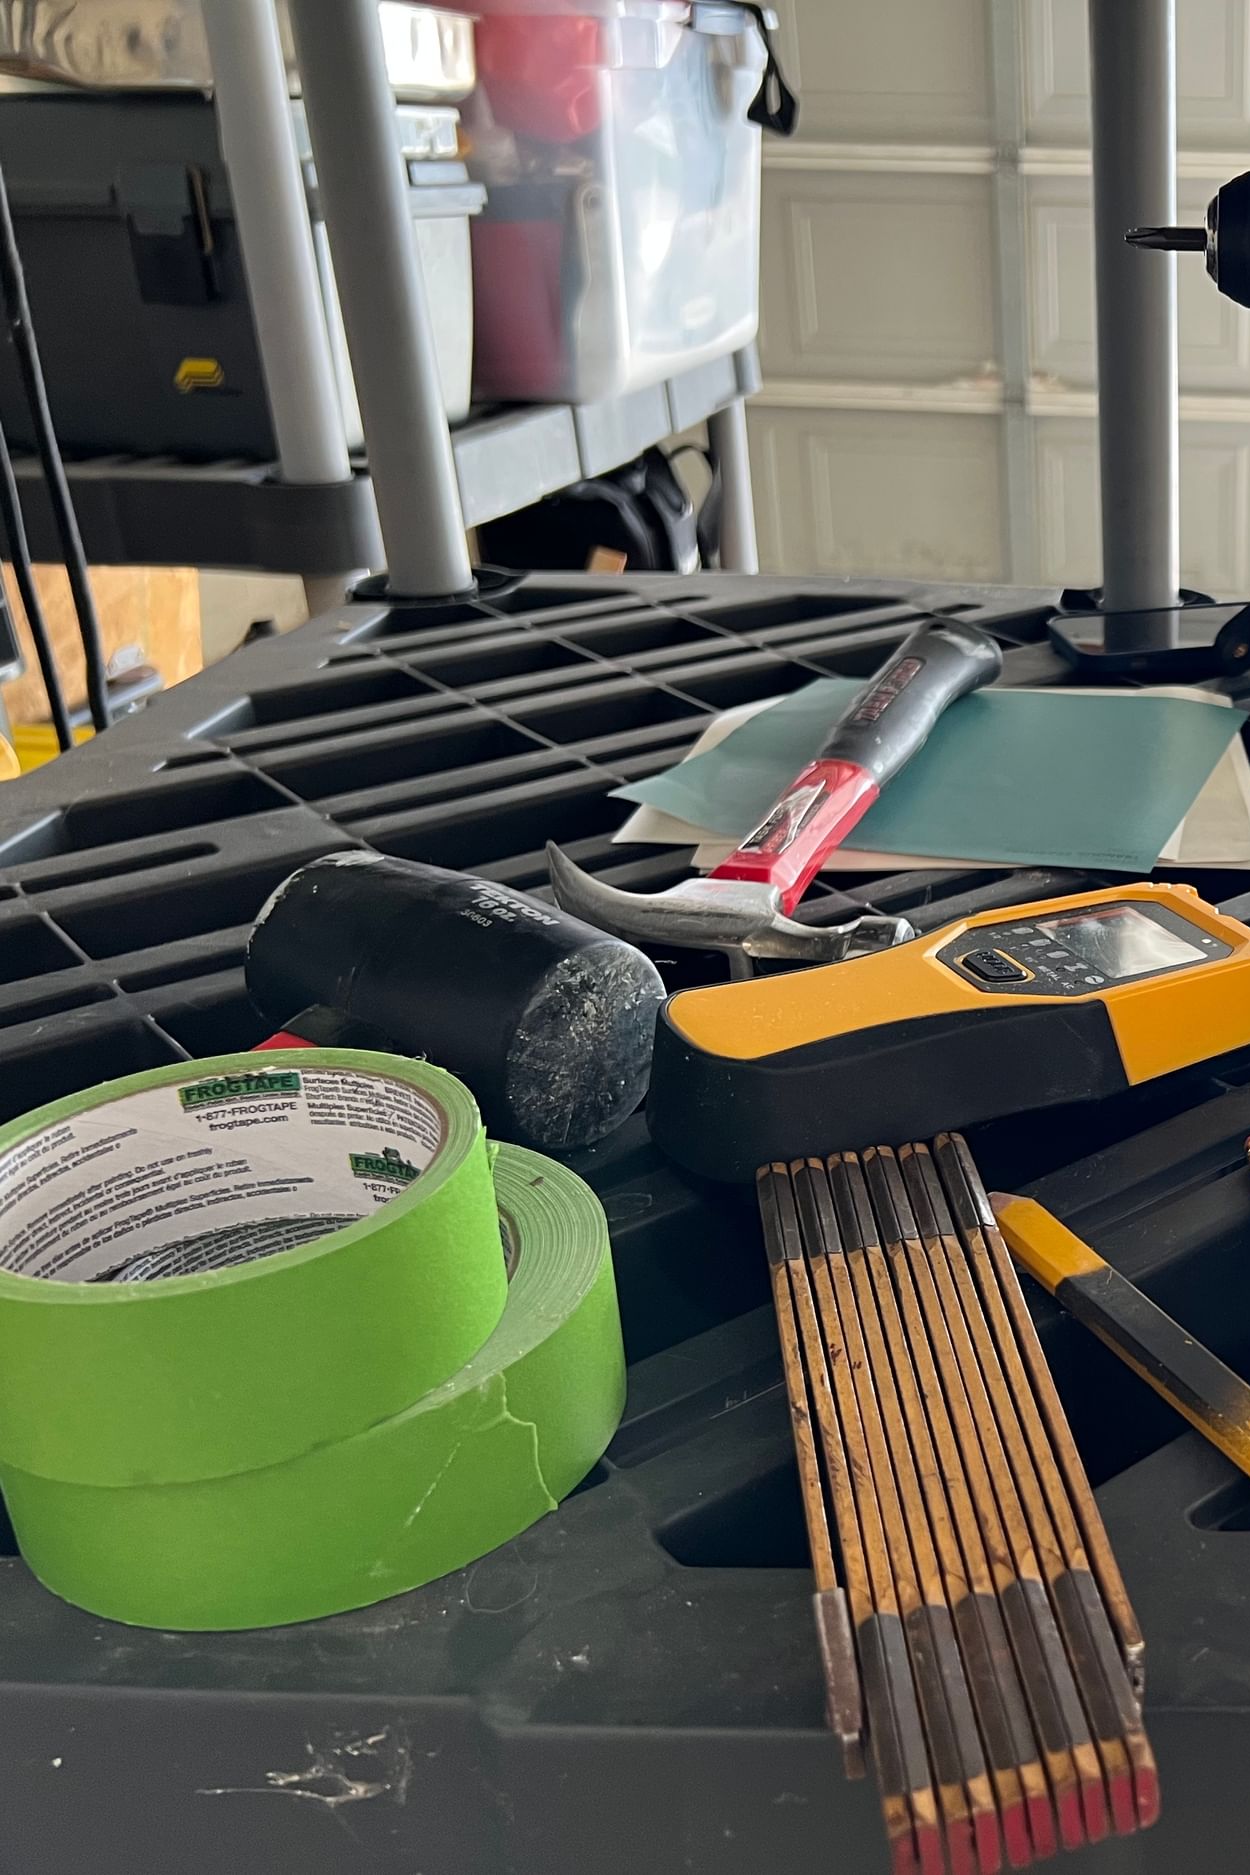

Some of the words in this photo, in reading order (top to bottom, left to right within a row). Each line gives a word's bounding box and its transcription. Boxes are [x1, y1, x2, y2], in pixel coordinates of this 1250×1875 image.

[469, 883, 560, 925] TEKTON
[471, 895, 500, 909] 16
[184, 1075, 295, 1101] FROGTAPE
[195, 1101, 298, 1122] 1-877-FROGTAPE
[208, 1114, 289, 1131] frogtape.com
[354, 1156, 419, 1180] FROGTA
[362, 1182, 401, 1195] 1-877-FR
